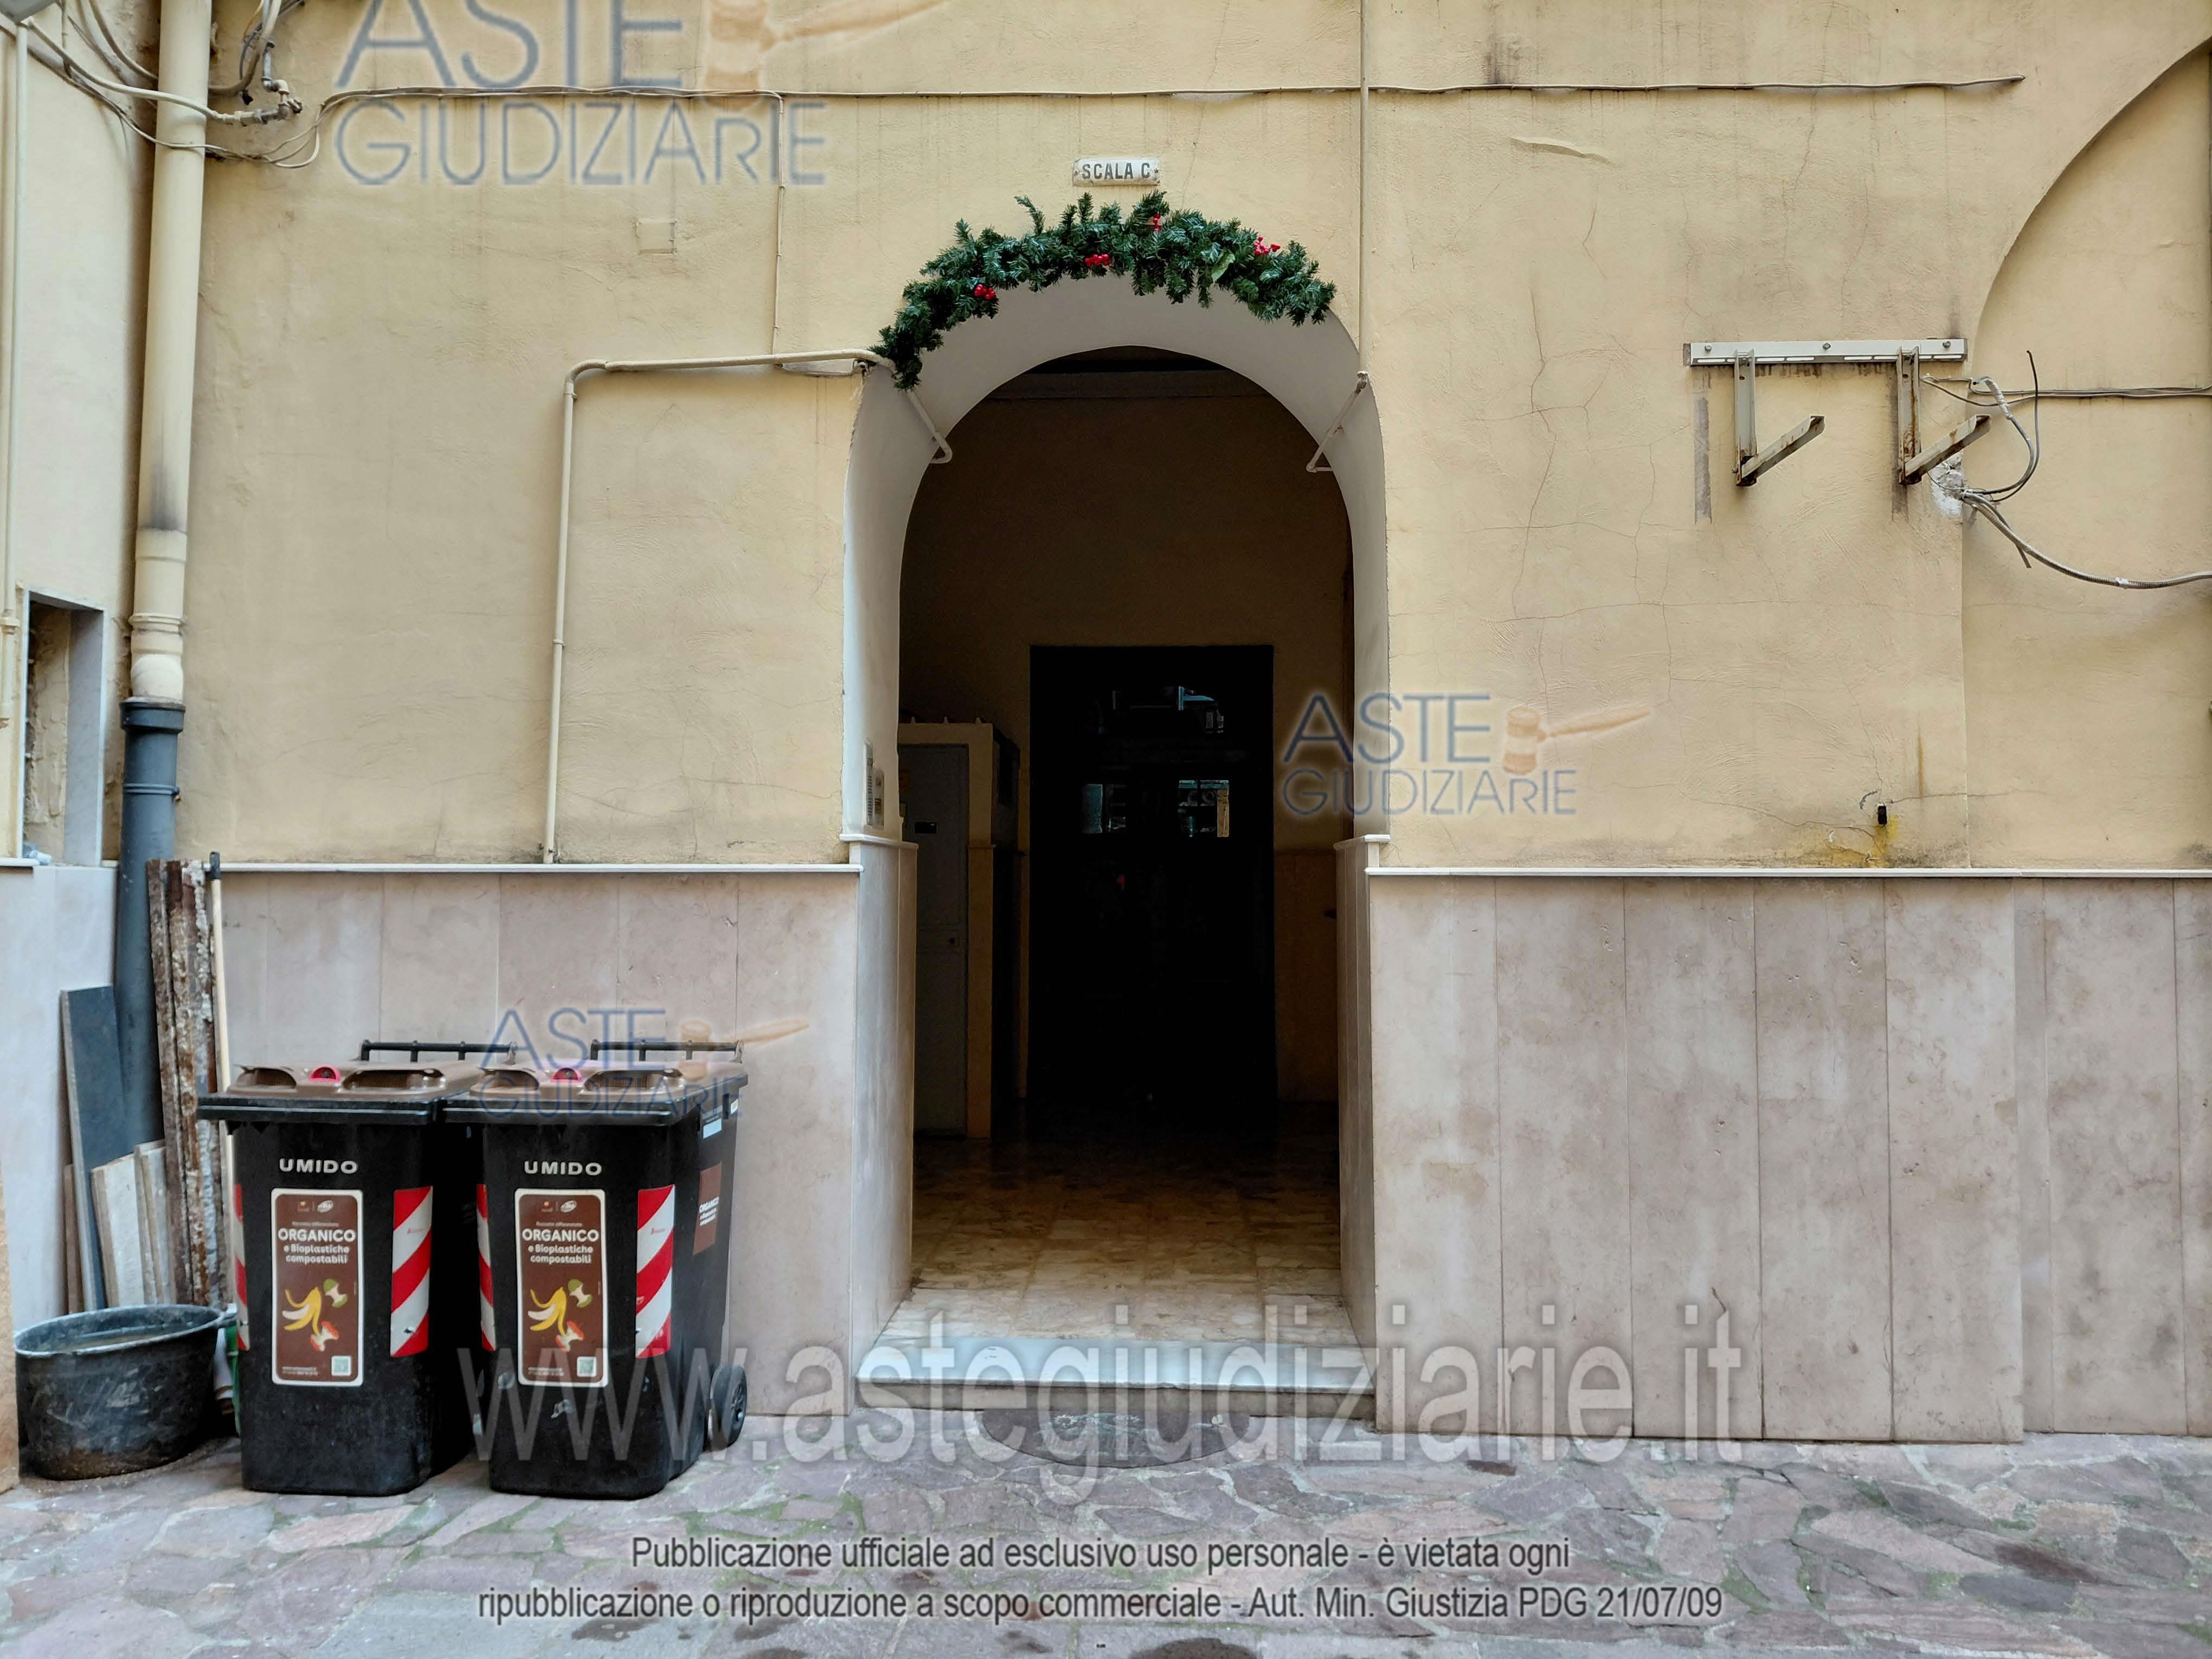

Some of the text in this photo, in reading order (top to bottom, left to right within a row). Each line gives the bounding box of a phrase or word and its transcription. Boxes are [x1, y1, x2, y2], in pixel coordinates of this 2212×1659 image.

[1082, 162, 1150, 179] SCALA C
[279, 1158, 358, 1174] UMIDO
[524, 1161, 603, 1176] UMIDO
[278, 1227, 356, 1243] ORGANICO
[522, 1228, 600, 1243] ORGANICO
[284, 1244, 350, 1255] e Bioplastiche
[528, 1244, 594, 1255] e Bioplastiche
[286, 1254, 348, 1265] compostabili
[530, 1254, 592, 1265] compostabili
